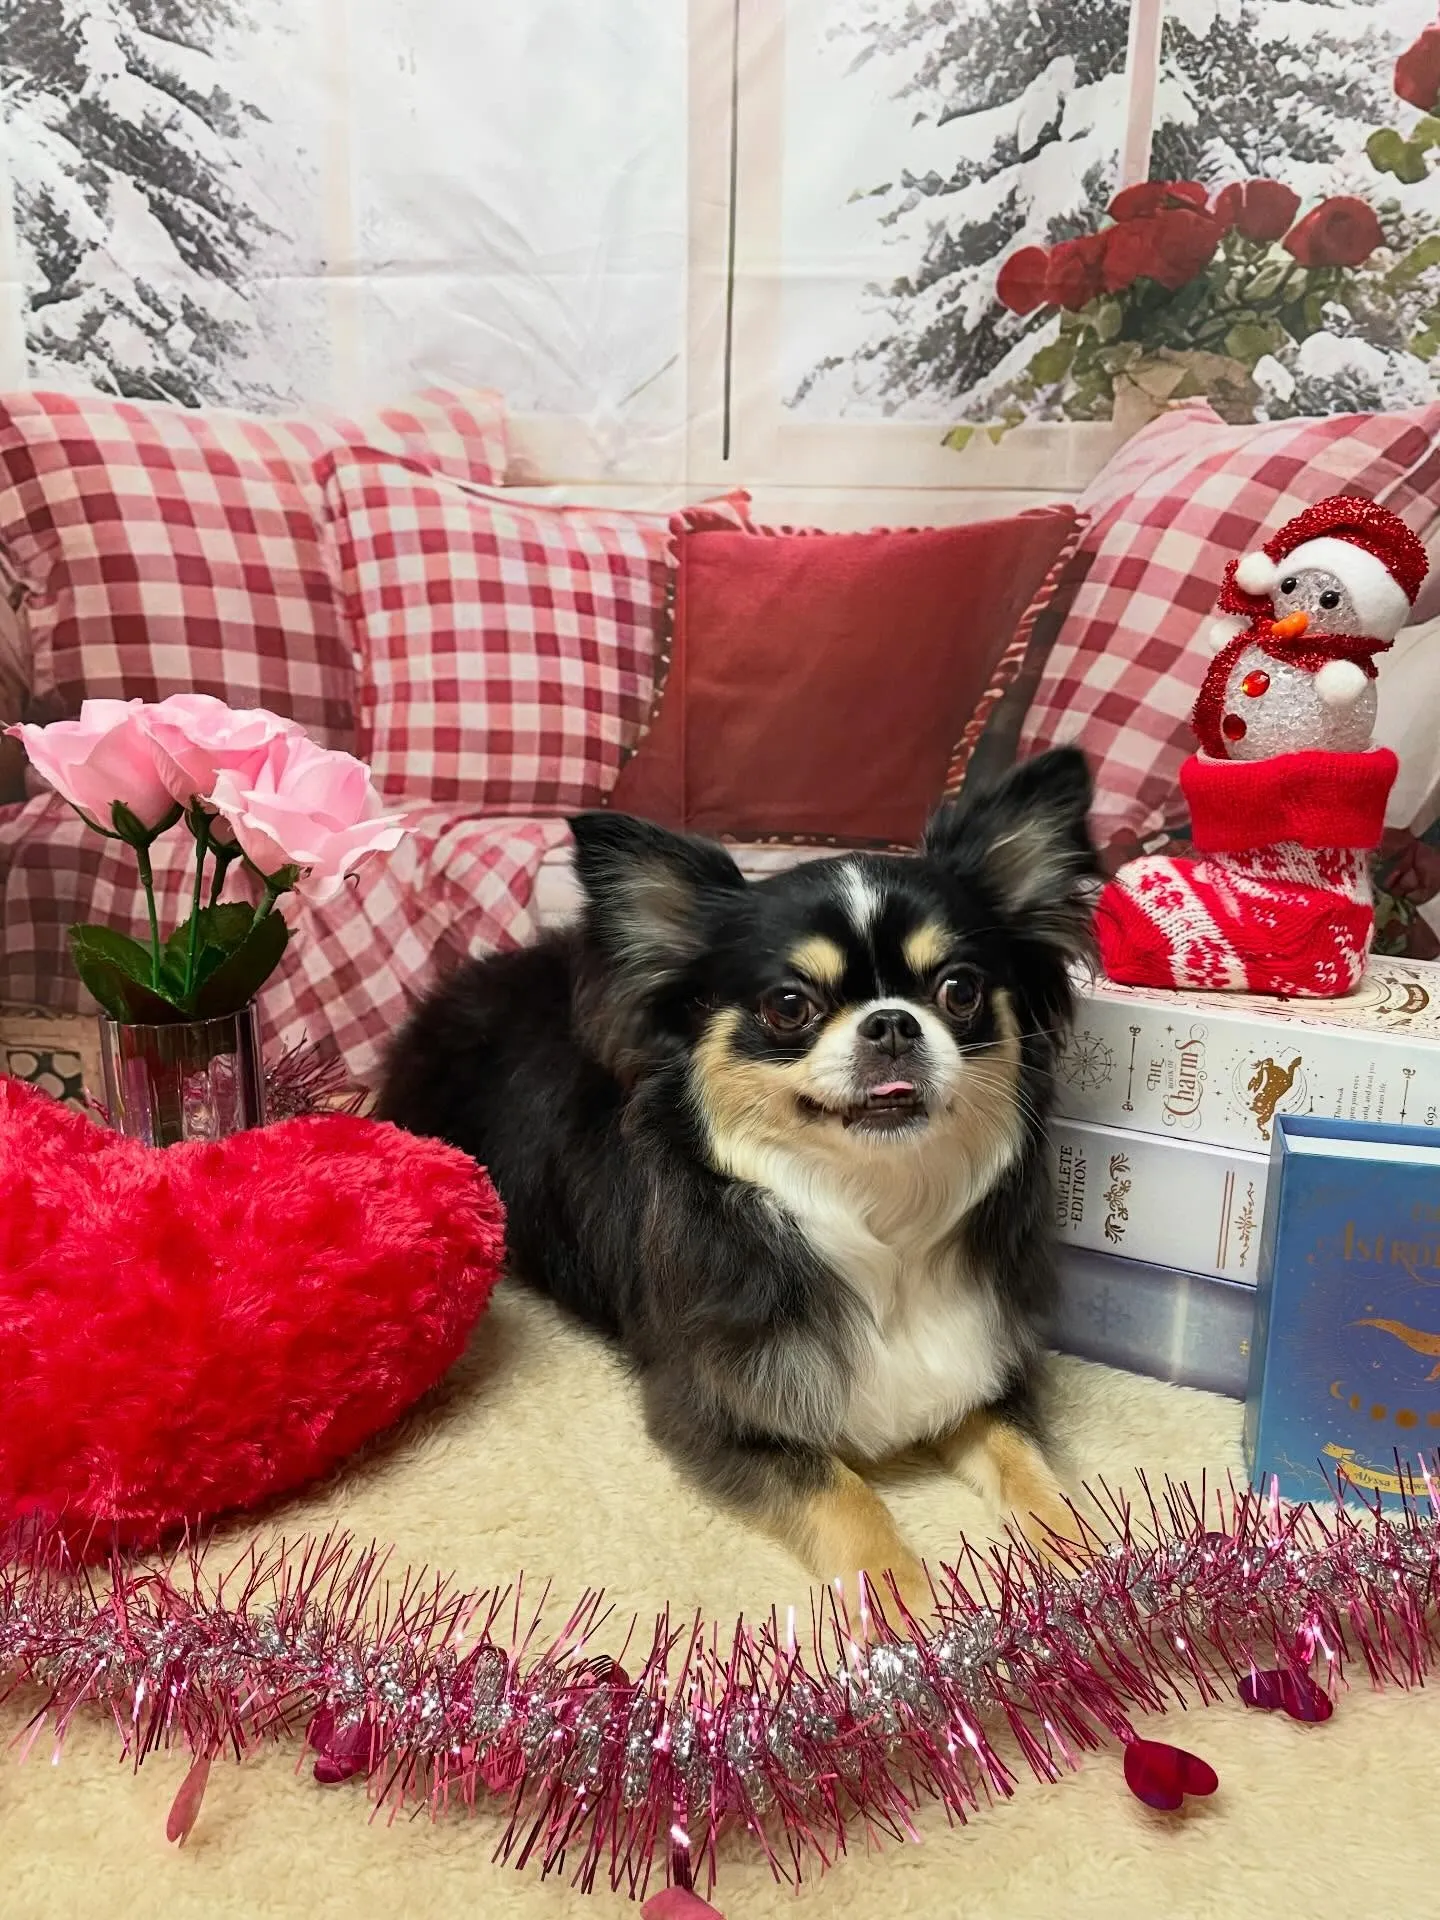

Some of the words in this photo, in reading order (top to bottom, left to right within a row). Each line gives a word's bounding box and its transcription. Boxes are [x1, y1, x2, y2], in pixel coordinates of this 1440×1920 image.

[1167, 1060, 1175, 1068] OF
[1147, 1058, 1165, 1091] THE
[1167, 1070, 1175, 1089] BOOK
[1362, 1105, 1371, 1120] orld,
[1424, 1105, 1438, 1127] 692
[1354, 1471, 1391, 1488] Alyssa
